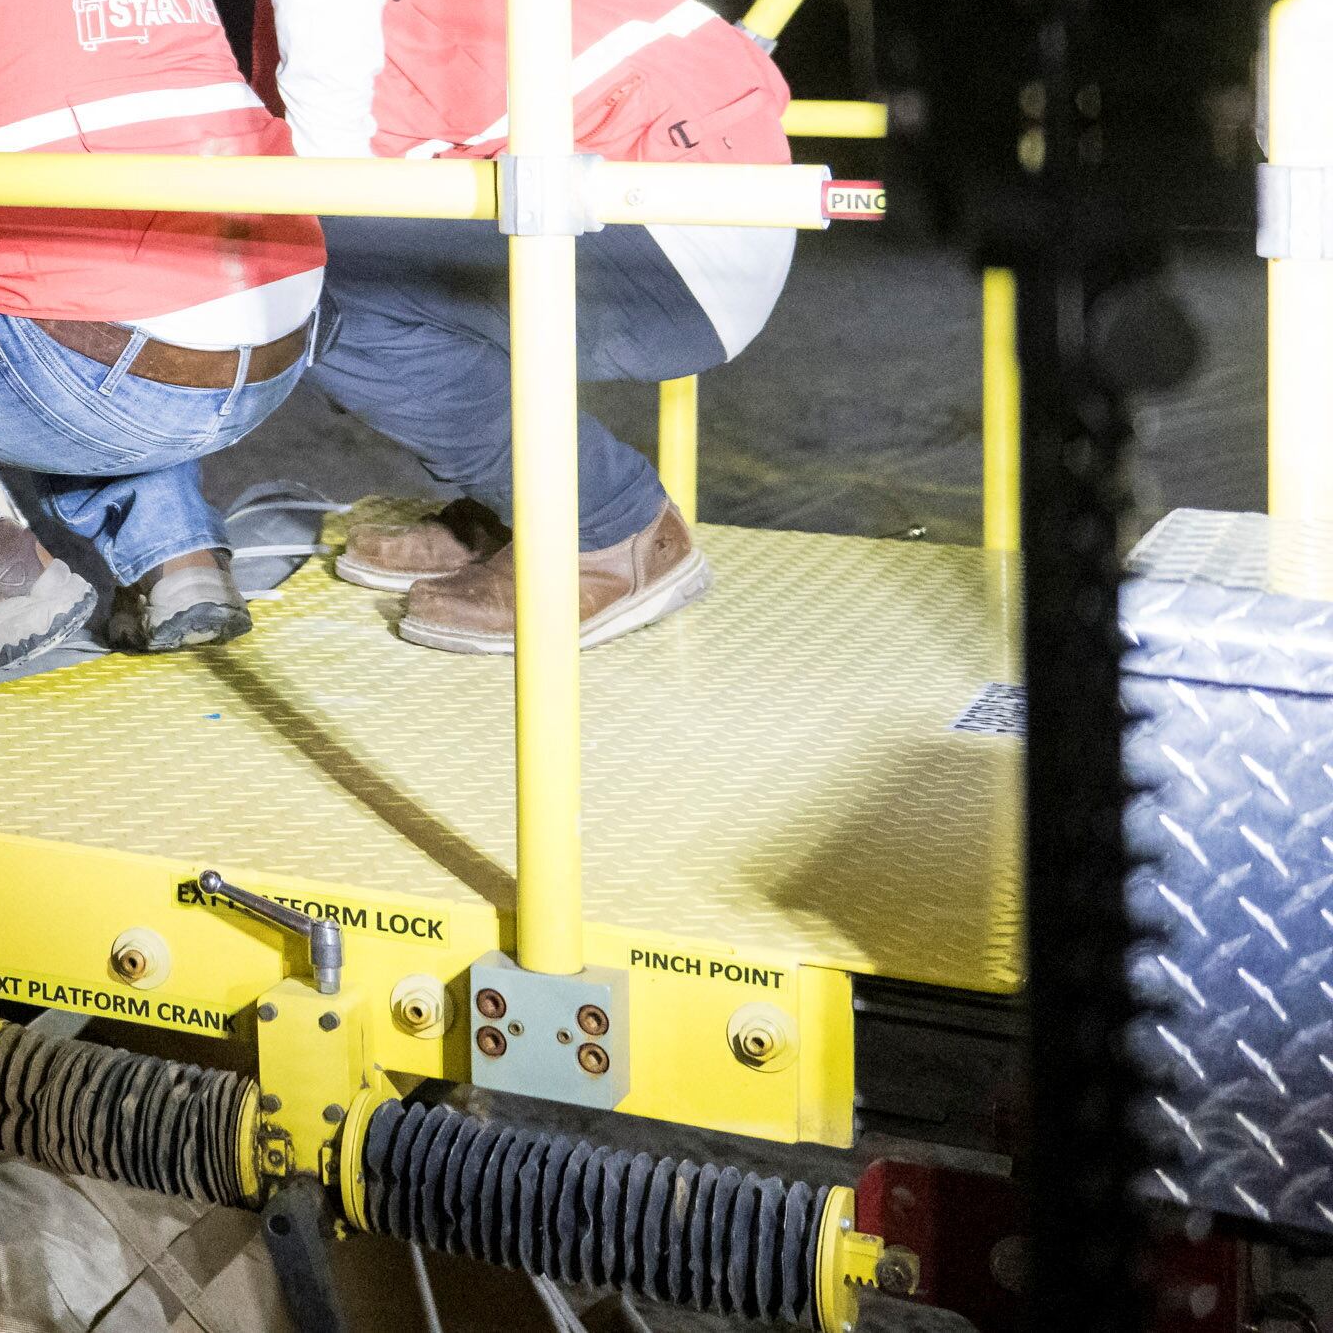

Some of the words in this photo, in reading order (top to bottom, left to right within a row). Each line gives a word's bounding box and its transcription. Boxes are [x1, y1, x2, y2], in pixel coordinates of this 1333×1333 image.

[376, 911, 445, 942] LOCK
[630, 948, 702, 976] PINCH
[709, 961, 785, 990] POINT
[28, 980, 151, 1018] PLATFORM
[156, 1002, 236, 1033] CRANK
